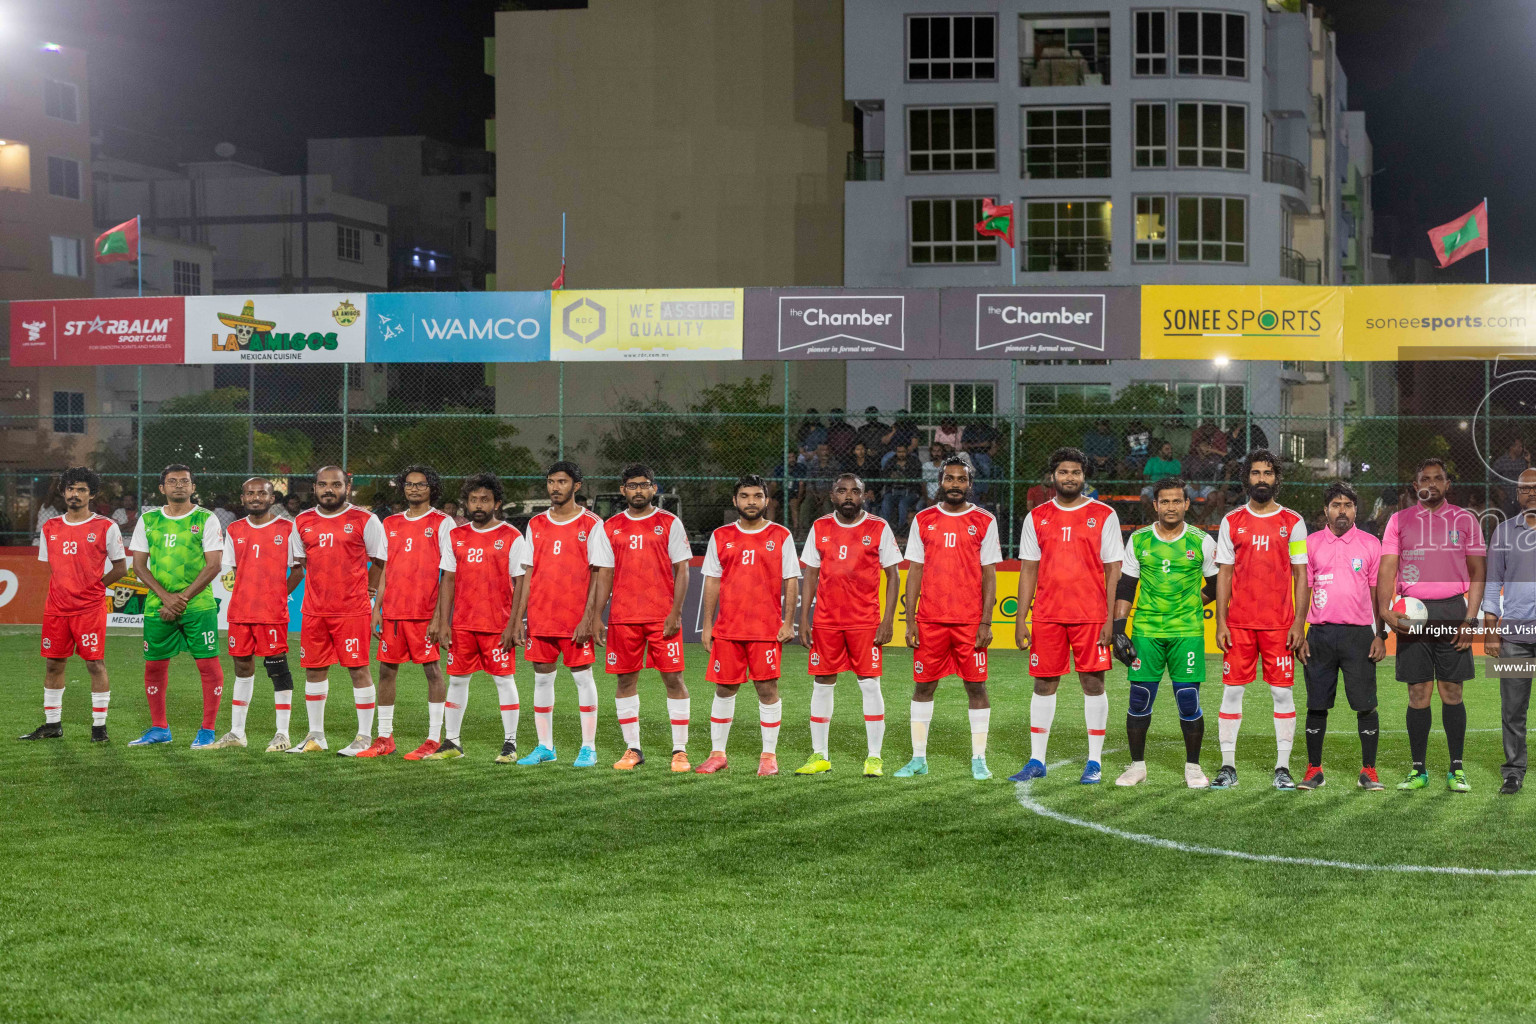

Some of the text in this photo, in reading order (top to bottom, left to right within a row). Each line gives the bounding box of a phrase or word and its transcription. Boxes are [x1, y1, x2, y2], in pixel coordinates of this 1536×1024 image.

[630, 302, 732, 318] WE ASSURE
[790, 308, 892, 326] the Chamber
[988, 306, 1093, 324] the Chamber
[1164, 310, 1320, 331] SONEE SPORTS
[1366, 315, 1527, 331] soneesports.com
[421, 318, 540, 340] WAMCO
[630, 322, 704, 336] QUALITY
[146, 334, 166, 342] CARE
[212, 332, 338, 352] LA AMIGOS
[807, 346, 830, 354] pioneer
[838, 346, 860, 354] formal
[164, 534, 177, 548] 12
[318, 532, 334, 548] 27
[944, 532, 956, 548] 10
[1061, 526, 1071, 542] 11
[62, 541, 78, 555] 23
[404, 538, 412, 552] 3
[553, 540, 561, 555] 8
[630, 534, 643, 550] 31
[1252, 534, 1270, 552] 44
[252, 544, 260, 558] 7
[742, 550, 755, 565] 21
[838, 545, 848, 560] 9
[1162, 559, 1171, 574] 2
[82, 633, 98, 646] 23
[202, 630, 215, 645] 12
[269, 629, 277, 642] 7
[345, 638, 359, 652] 27
[667, 642, 680, 657] 31
[872, 646, 880, 662] 9
[973, 652, 986, 666] 10
[1276, 656, 1292, 672] 44
